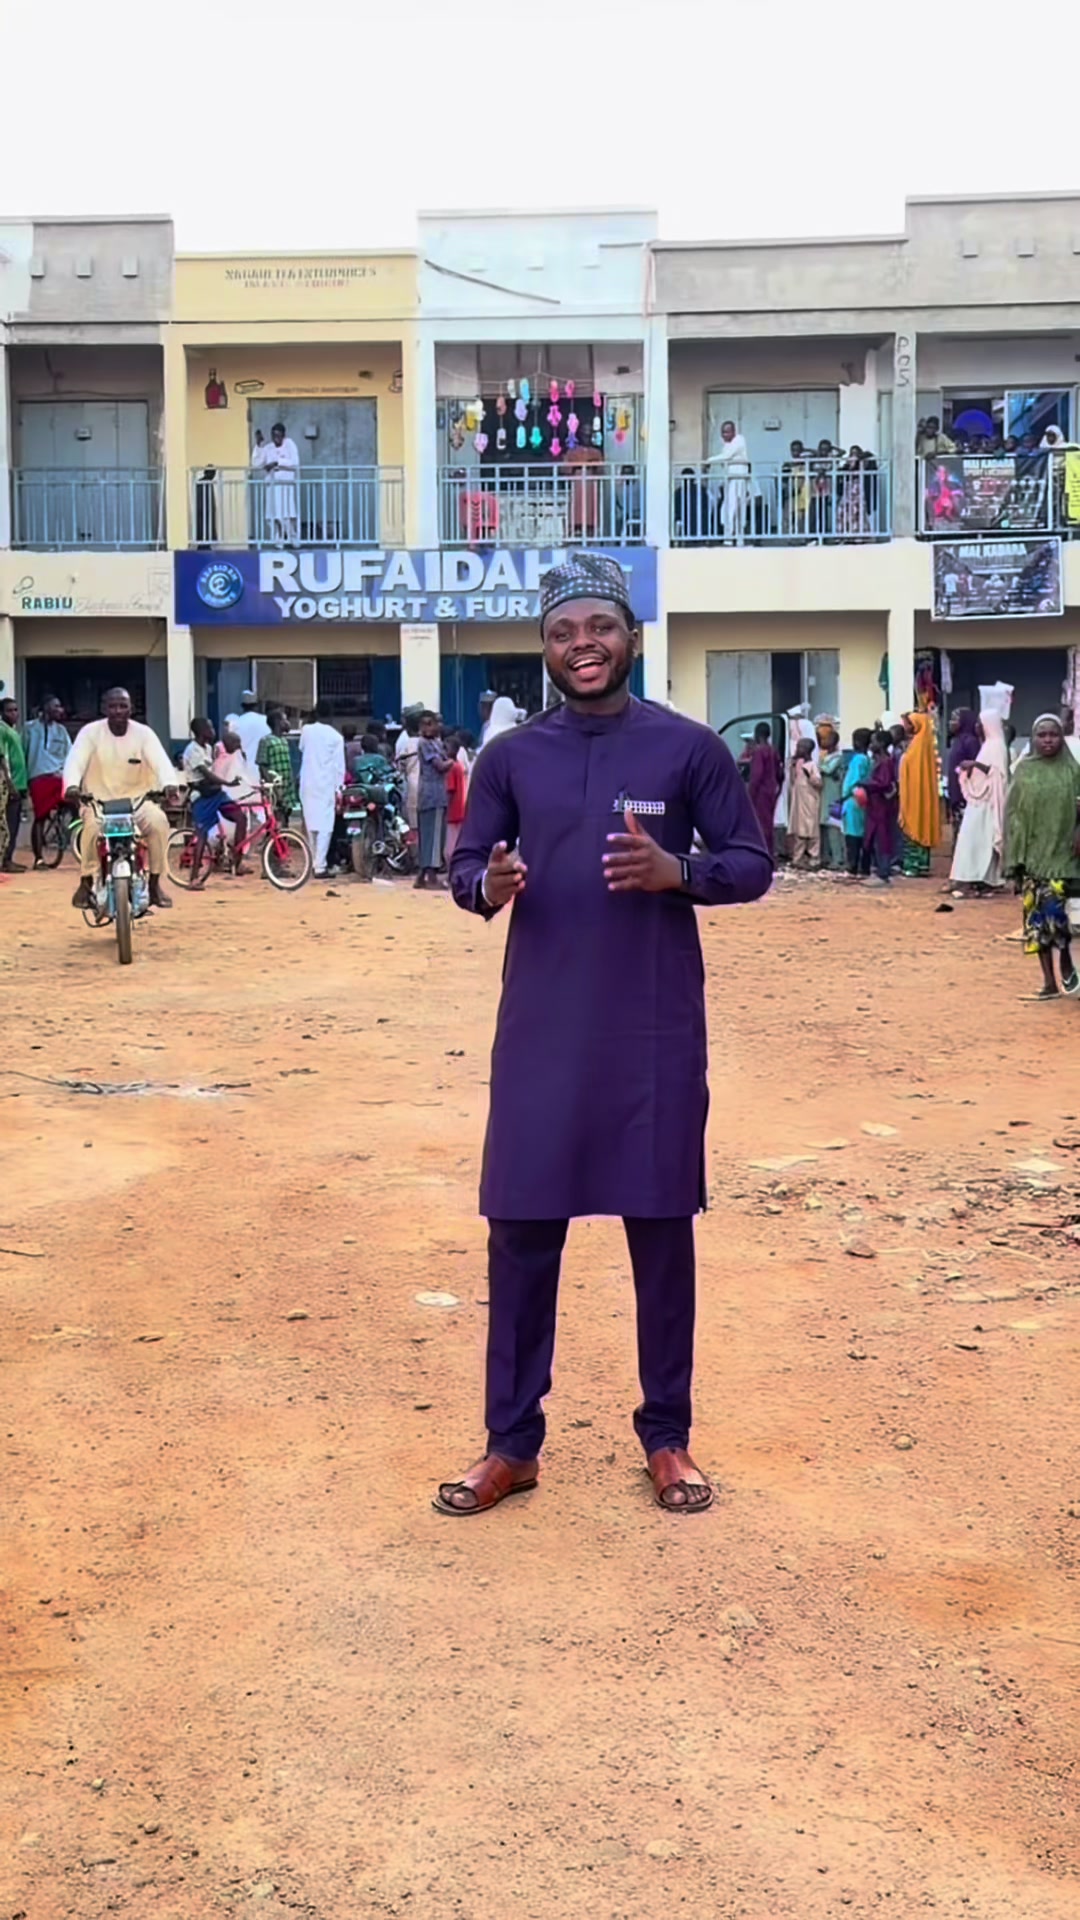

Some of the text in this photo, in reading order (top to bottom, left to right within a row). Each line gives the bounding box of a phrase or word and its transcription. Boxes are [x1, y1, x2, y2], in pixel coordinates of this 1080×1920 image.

[259, 551, 565, 593] RUFAIDAH
[22, 596, 73, 610] RABIU
[273, 597, 427, 619] YOGHURT
[434, 597, 459, 619] &
